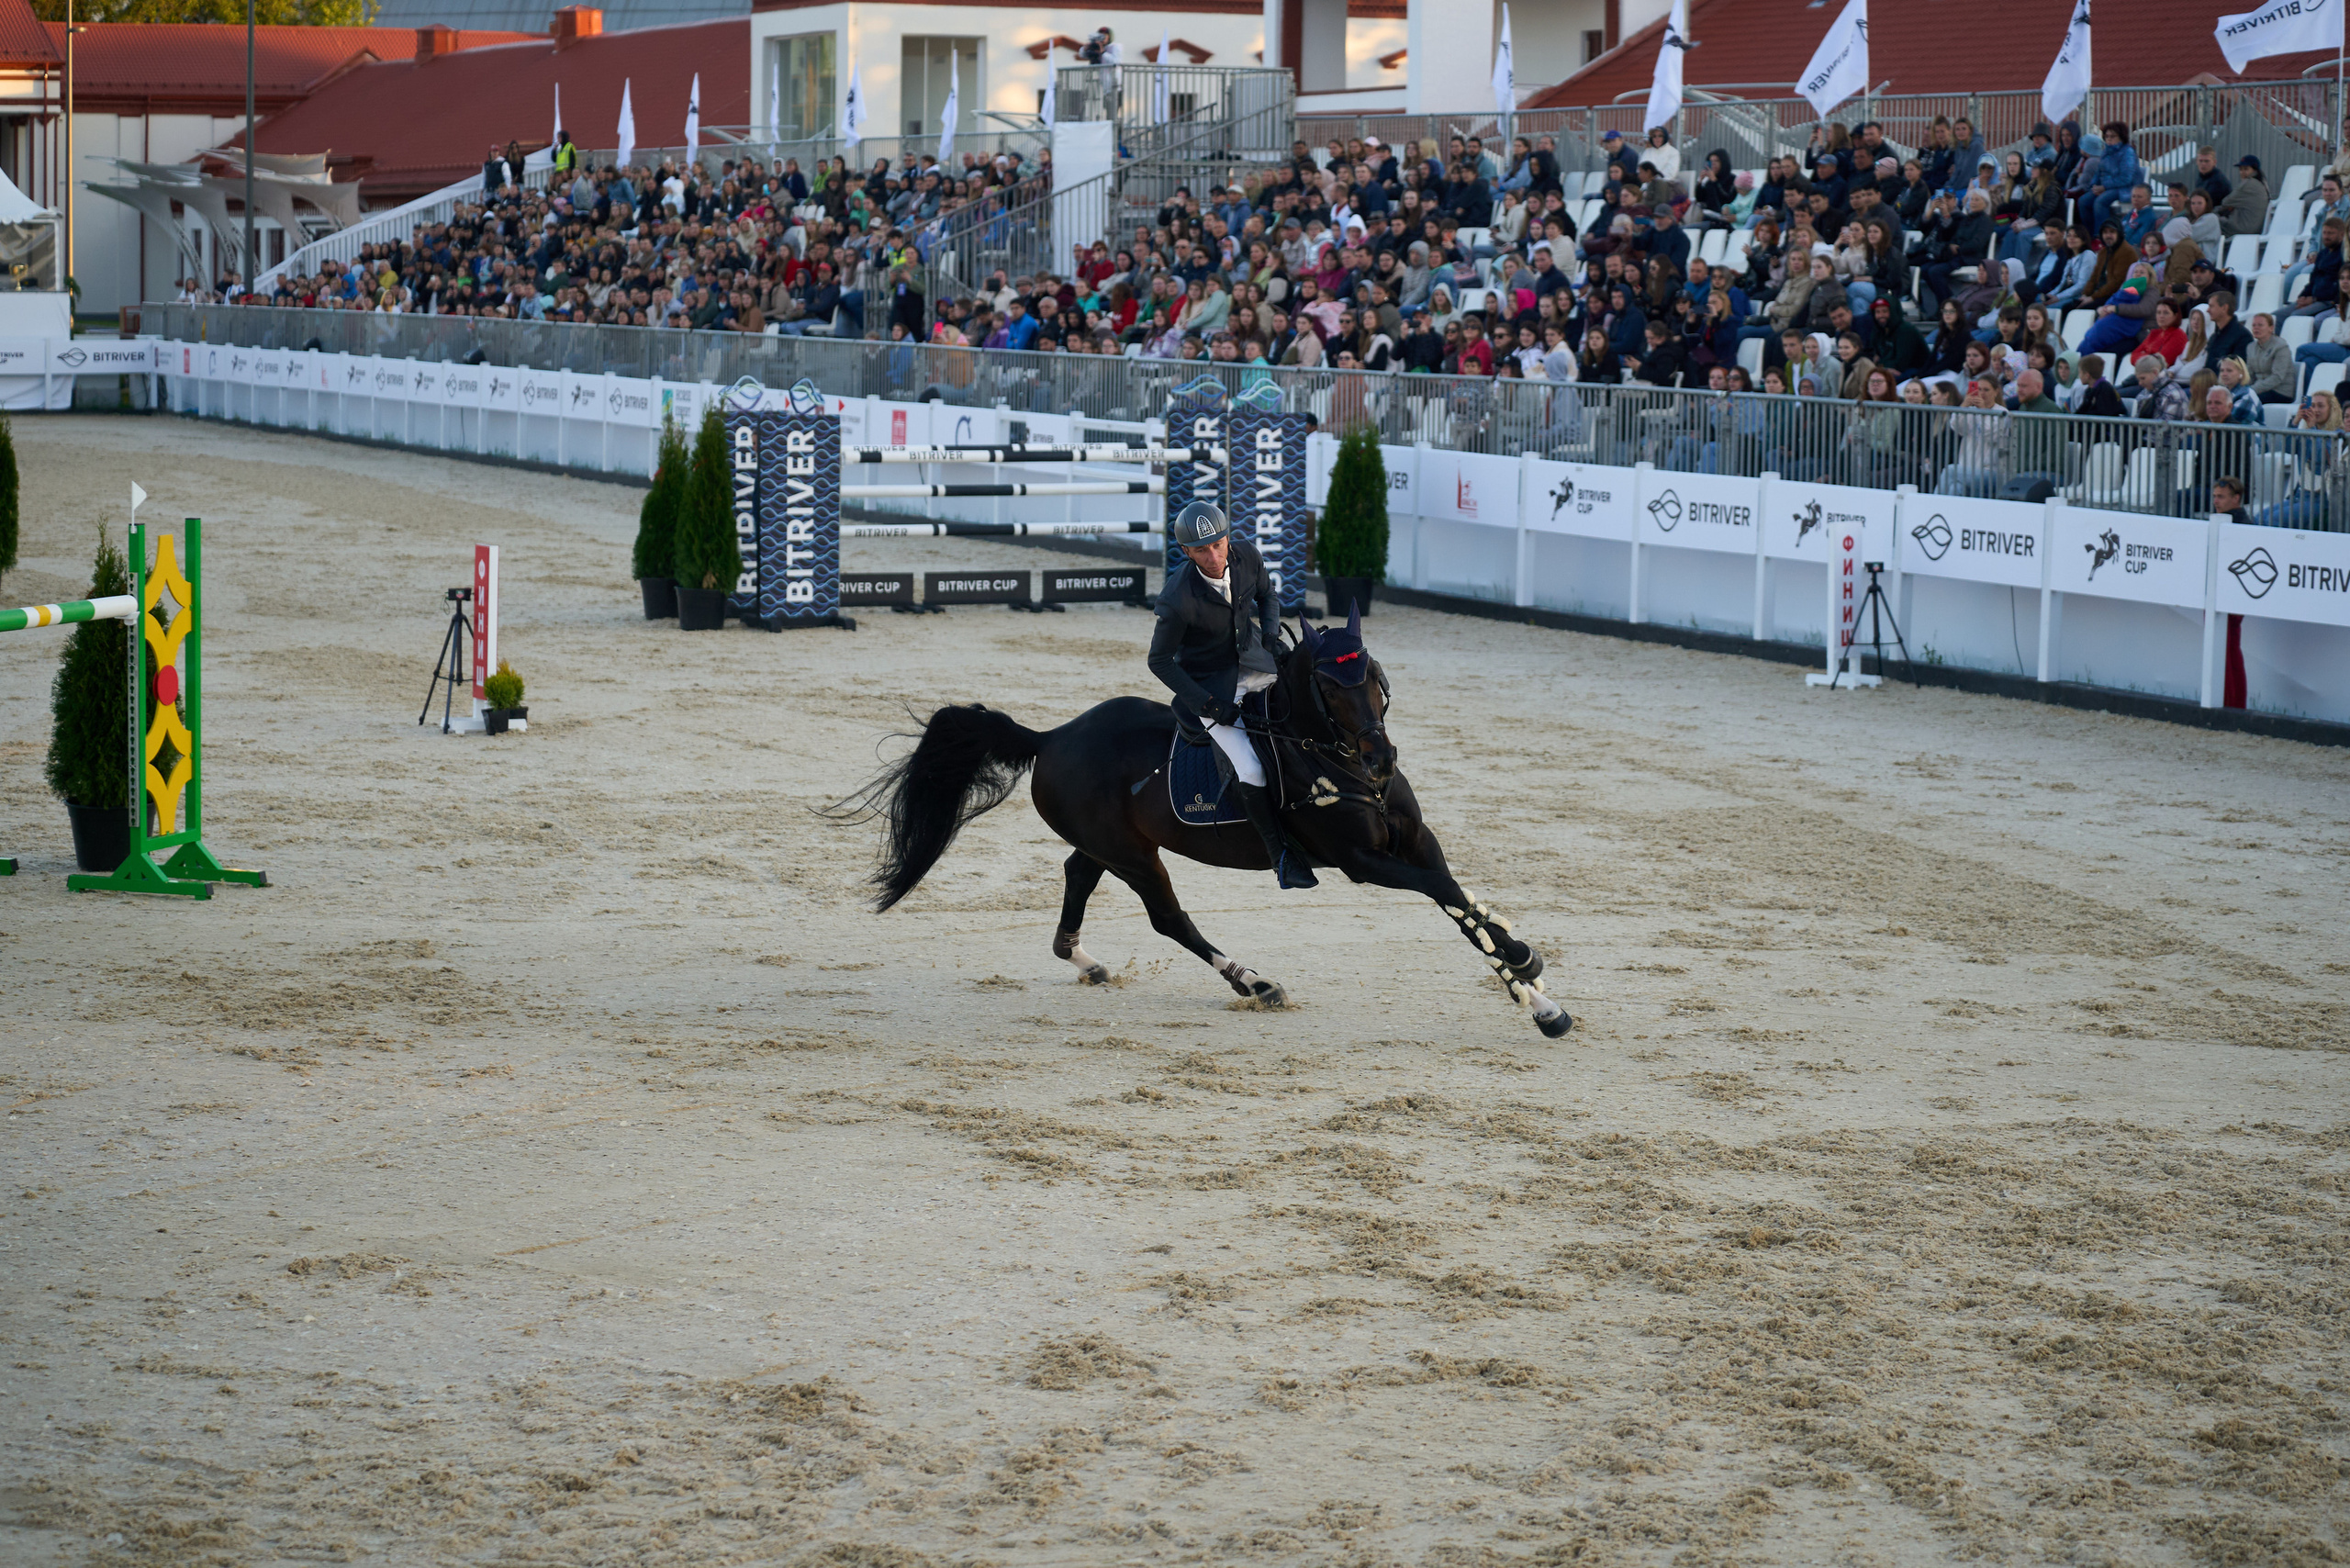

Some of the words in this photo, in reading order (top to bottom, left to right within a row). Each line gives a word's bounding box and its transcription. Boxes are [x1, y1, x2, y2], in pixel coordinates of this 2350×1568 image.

[93, 352, 145, 362] BITRIVER
[536, 386, 558, 400] BITRIVER
[624, 395, 648, 409] BITRIVER
[909, 450, 963, 460] BITRIVER
[1113, 449, 1165, 459] BITRIVER
[1577, 488, 1611, 503] BITRIVER
[1577, 504, 1594, 514] CUP
[1689, 502, 1751, 527] BITRIVER
[786, 430, 815, 603] BITRIVER
[855, 528, 908, 537] BITRIVER
[1053, 525, 1104, 534] BITRIVER
[1961, 529, 2034, 557] BITRIVER
[2126, 543, 2174, 562] BITRIVER
[2125, 560, 2147, 574] CUP
[1055, 577, 1106, 590] BITRIVER
[1109, 577, 1134, 588] CUP
[2288, 564, 2350, 593] BITRIV
[839, 582, 871, 594] RIVER
[875, 581, 901, 593] CUP
[937, 579, 990, 592] BITRIVER
[992, 579, 1018, 591] CUP
[1184, 804, 1216, 812] KENTUCKY
